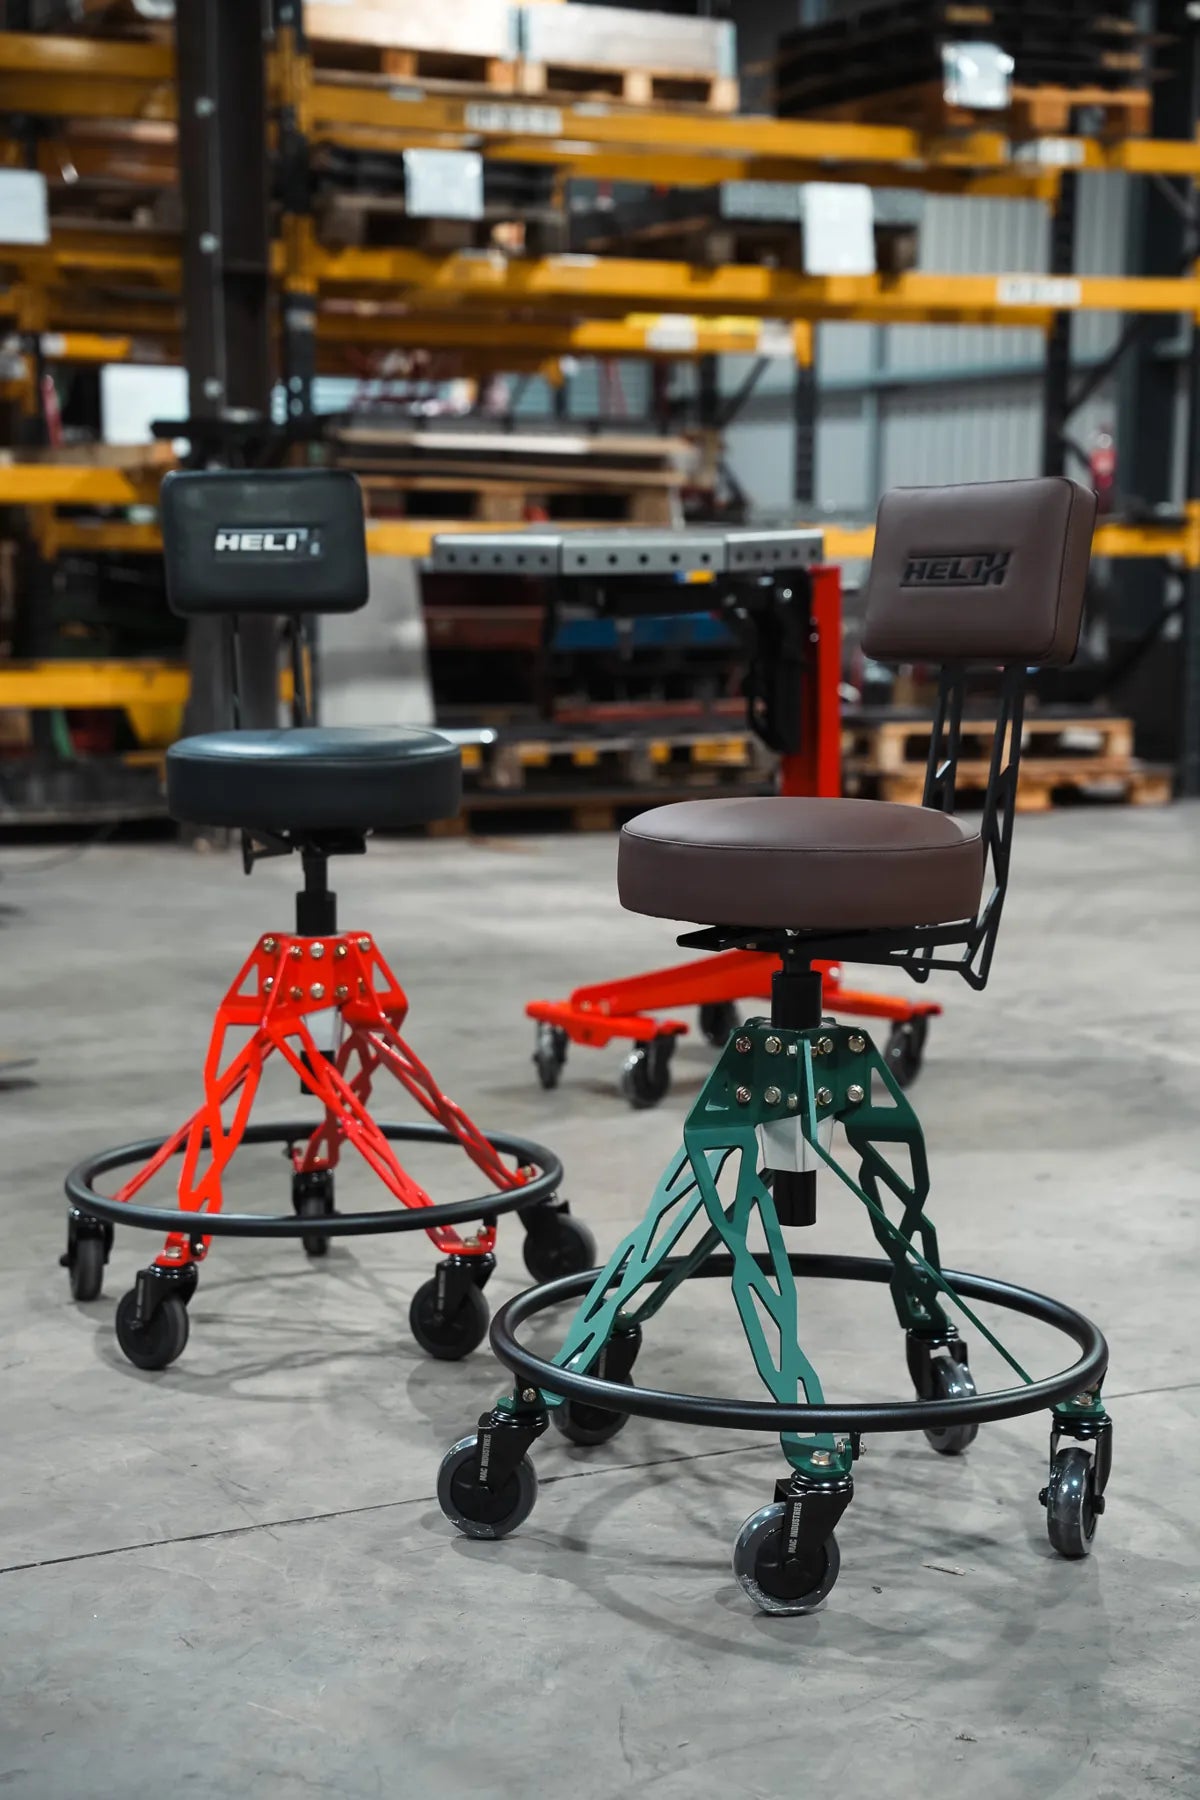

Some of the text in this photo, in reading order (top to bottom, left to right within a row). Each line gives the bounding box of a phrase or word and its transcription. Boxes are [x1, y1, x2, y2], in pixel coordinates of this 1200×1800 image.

[901, 552, 1012, 587] HELIX
[479, 1434, 492, 1481] MAC INDUSTRIES
[788, 1502, 802, 1553] MAC INDUSTRIES
